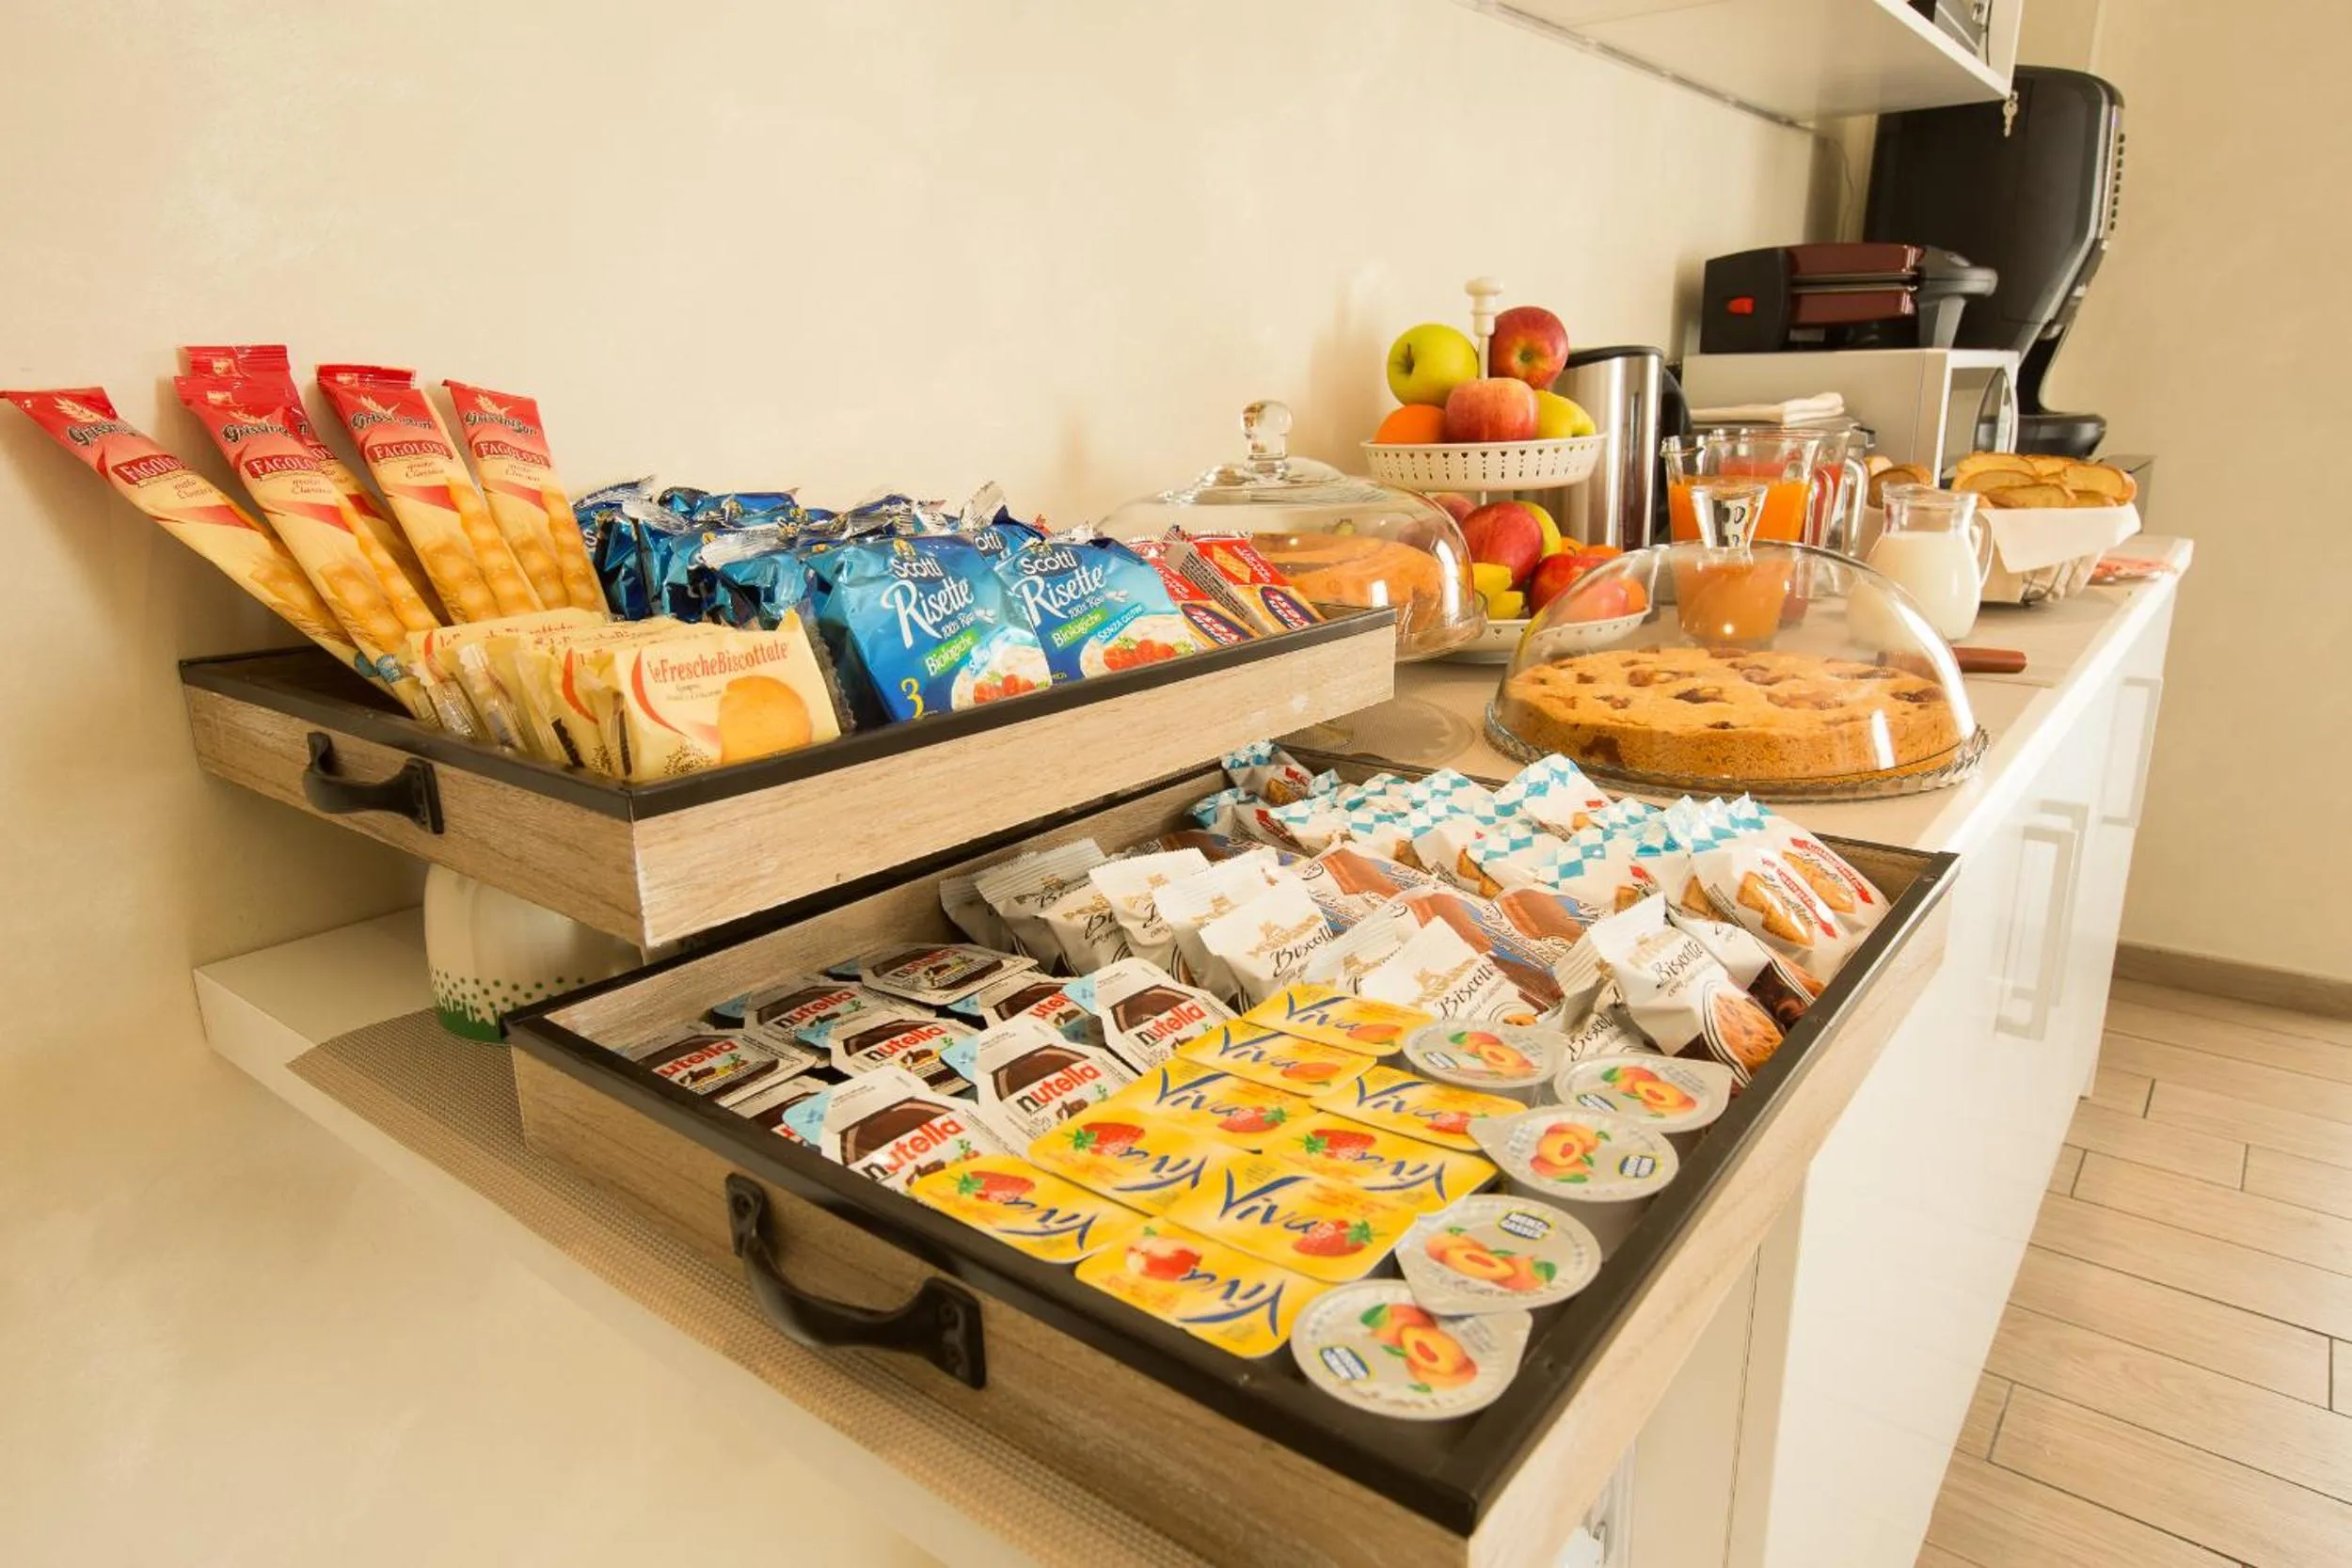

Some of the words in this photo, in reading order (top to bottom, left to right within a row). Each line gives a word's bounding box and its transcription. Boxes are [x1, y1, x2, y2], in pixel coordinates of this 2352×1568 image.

[975, 531, 1003, 551] otti
[890, 556, 944, 578] Scotti
[1020, 549, 1078, 575] Scotti
[881, 576, 975, 649] Risette
[1008, 564, 1107, 627] Risette
[773, 990, 856, 1028] nutella
[1135, 1004, 1206, 1046] nutella
[657, 1039, 739, 1077] utella
[864, 1024, 948, 1062] nutella
[1016, 1062, 1102, 1116] nutella
[862, 1117, 966, 1182] nutella
[1219, 1166, 1319, 1234] Viva
